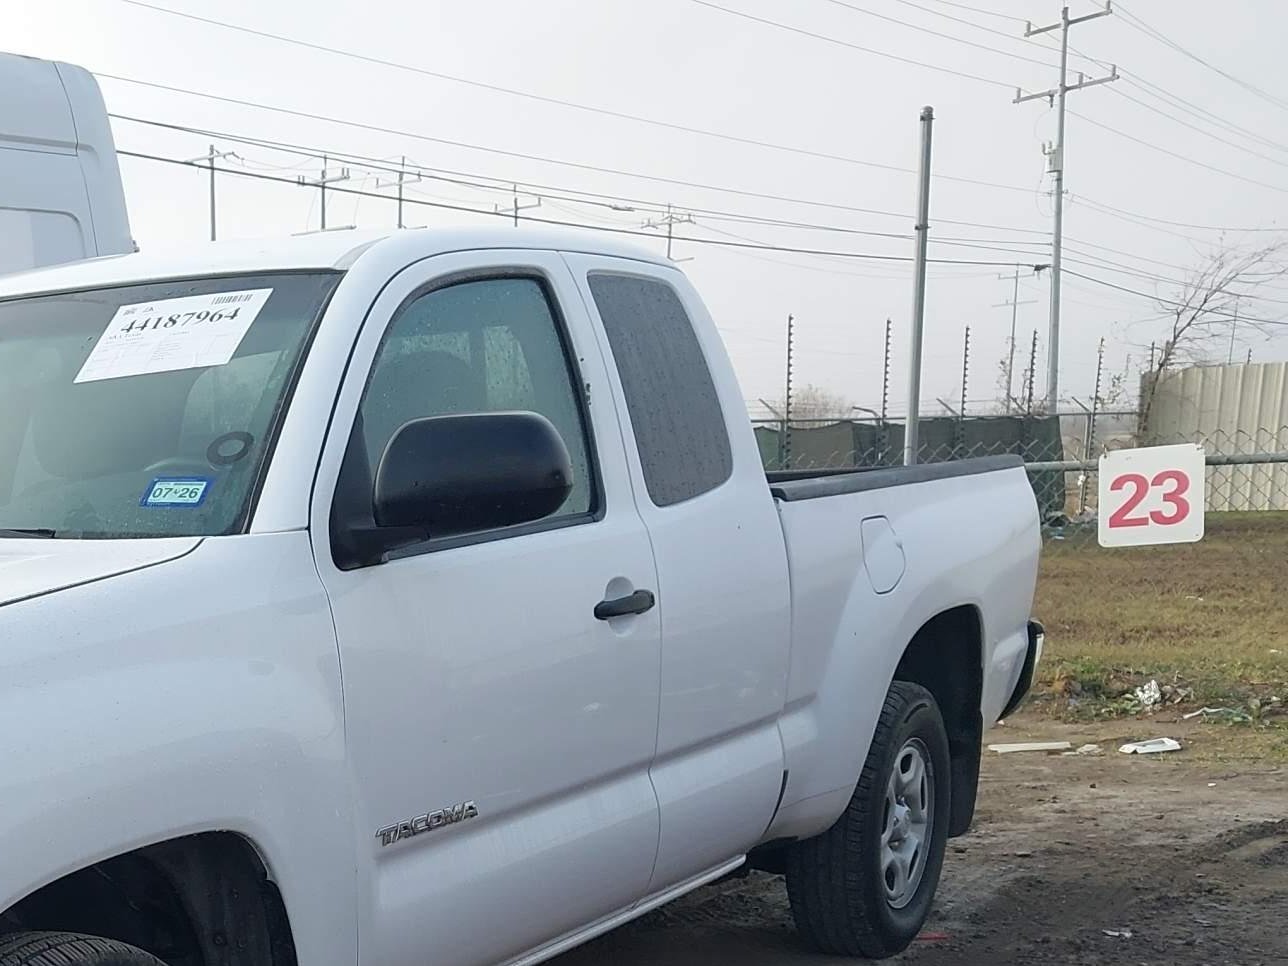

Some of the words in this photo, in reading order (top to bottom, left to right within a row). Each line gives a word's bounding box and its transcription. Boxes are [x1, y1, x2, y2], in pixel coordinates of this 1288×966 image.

[120, 306, 241, 333] 44187964
[152, 487, 173, 499] 07
[177, 487, 200, 499] 26
[1108, 469, 1191, 529] 23
[375, 800, 479, 847] TACOMA
